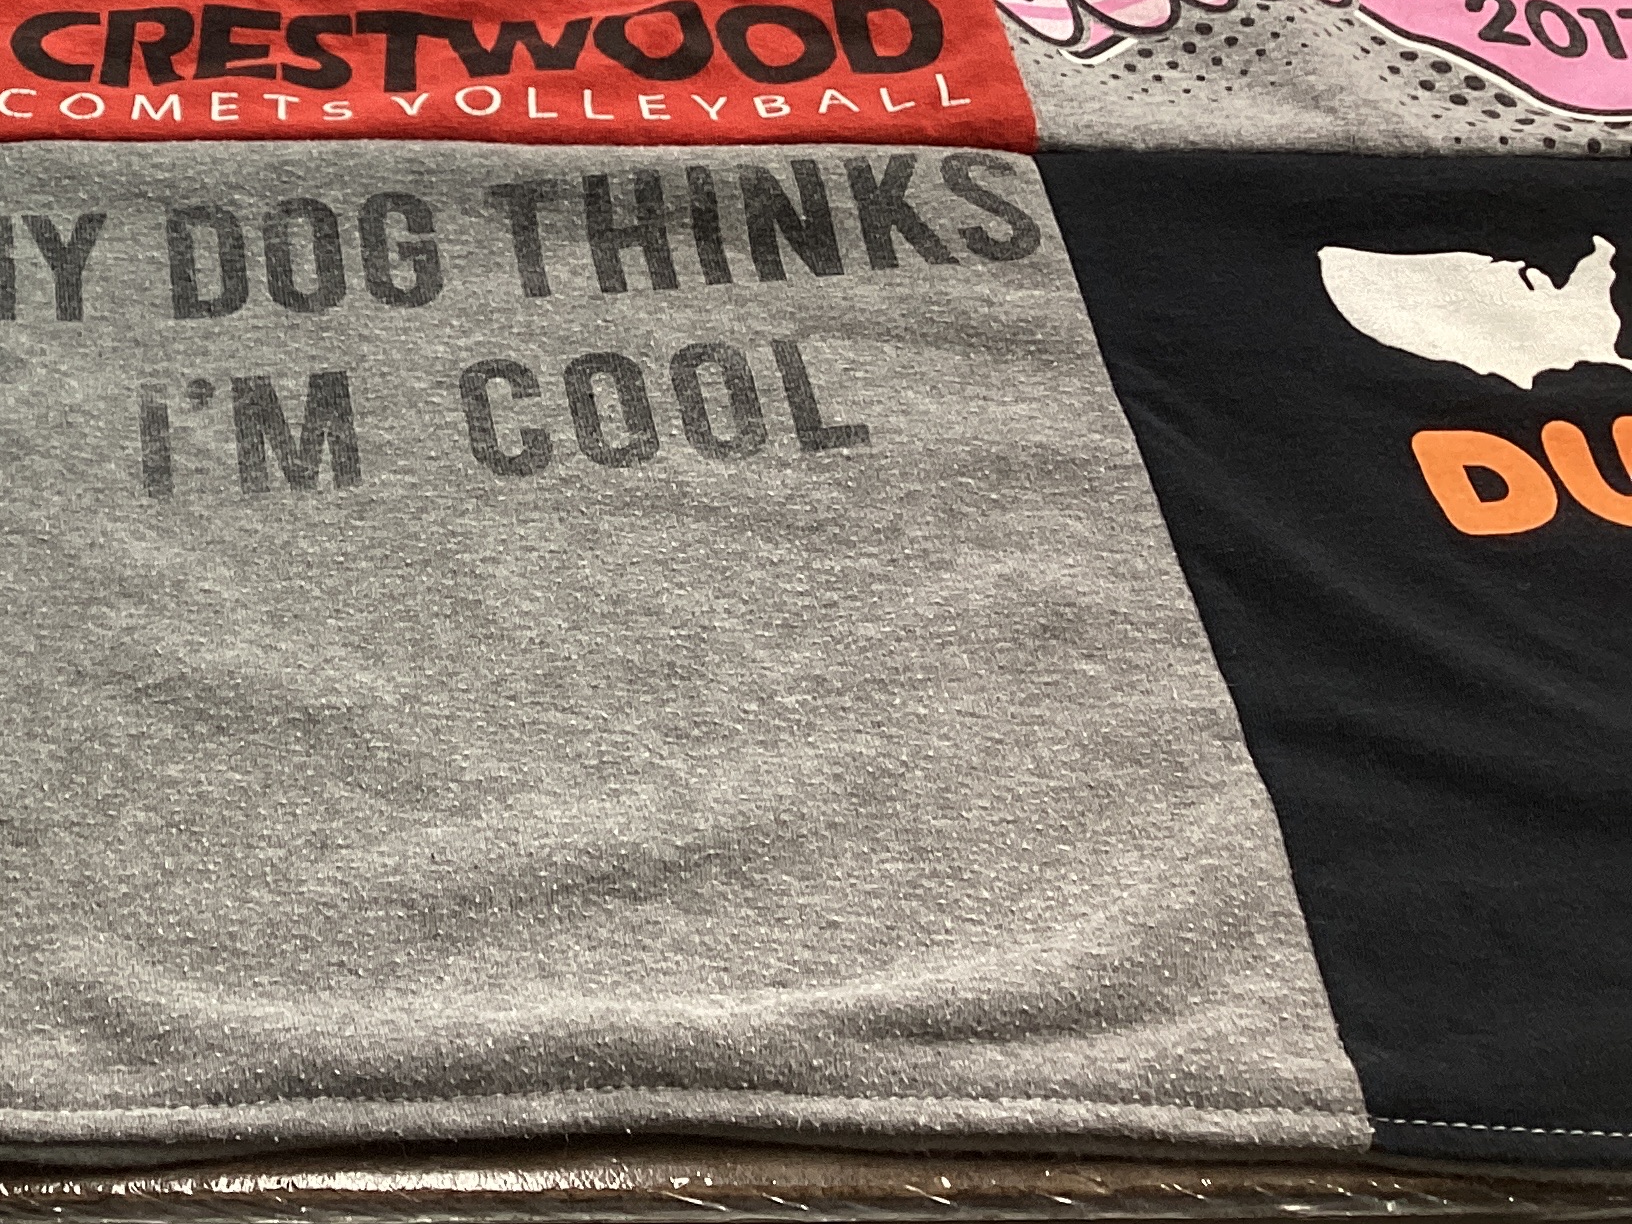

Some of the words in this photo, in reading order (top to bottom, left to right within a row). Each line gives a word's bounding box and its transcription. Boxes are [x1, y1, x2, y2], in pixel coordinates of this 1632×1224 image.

[391, 73, 973, 123] VOLLEYBALL
[167, 191, 445, 320] DOG
[483, 152, 1042, 298] THINKS
[136, 371, 363, 498] I'M
[459, 338, 869, 477] COOL
